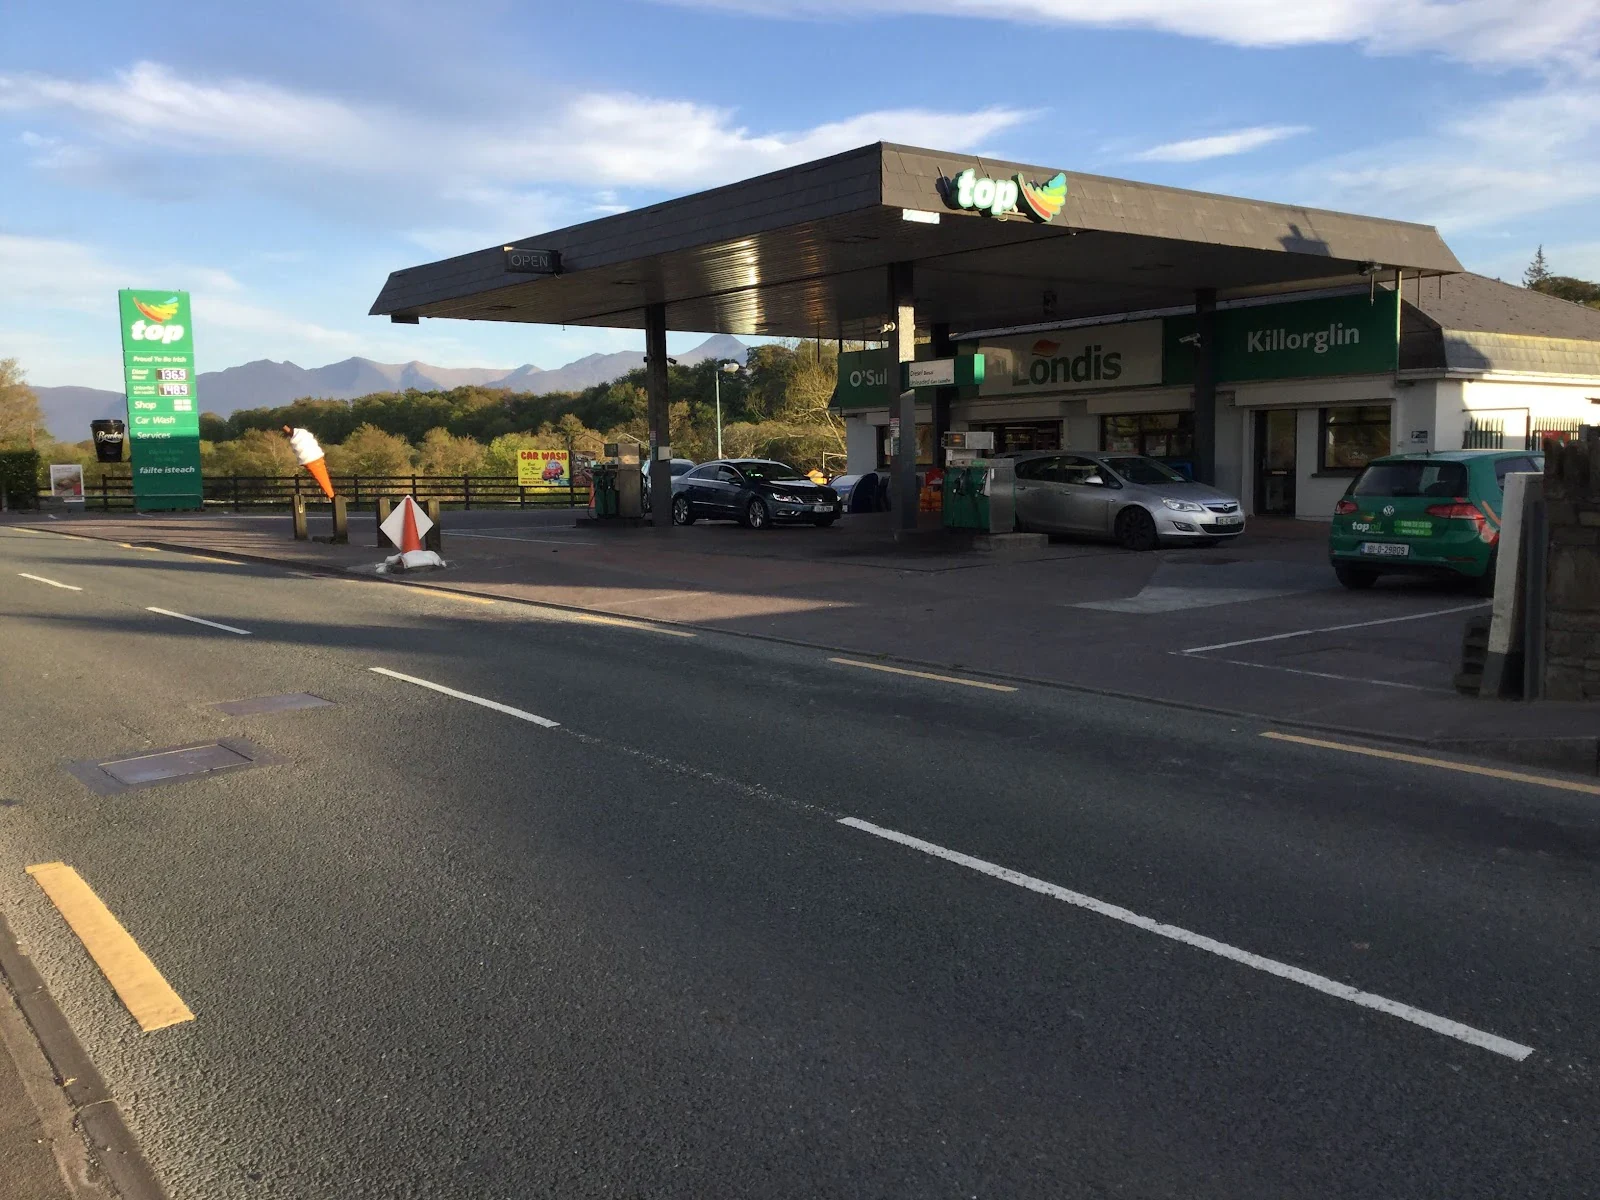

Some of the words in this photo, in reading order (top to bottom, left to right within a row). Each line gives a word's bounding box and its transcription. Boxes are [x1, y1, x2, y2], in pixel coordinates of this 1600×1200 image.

[958, 168, 1018, 216] top
[511, 255, 548, 267] OPEN
[131, 320, 184, 344] top
[1247, 322, 1360, 353] Killorglin
[1011, 345, 1122, 386] Londis
[849, 367, 888, 387] O'Sul
[134, 401, 156, 410] Shop
[135, 416, 150, 424] Car
[152, 416, 176, 424] Wash
[520, 451, 538, 460] CAR
[542, 452, 568, 460] WASH
